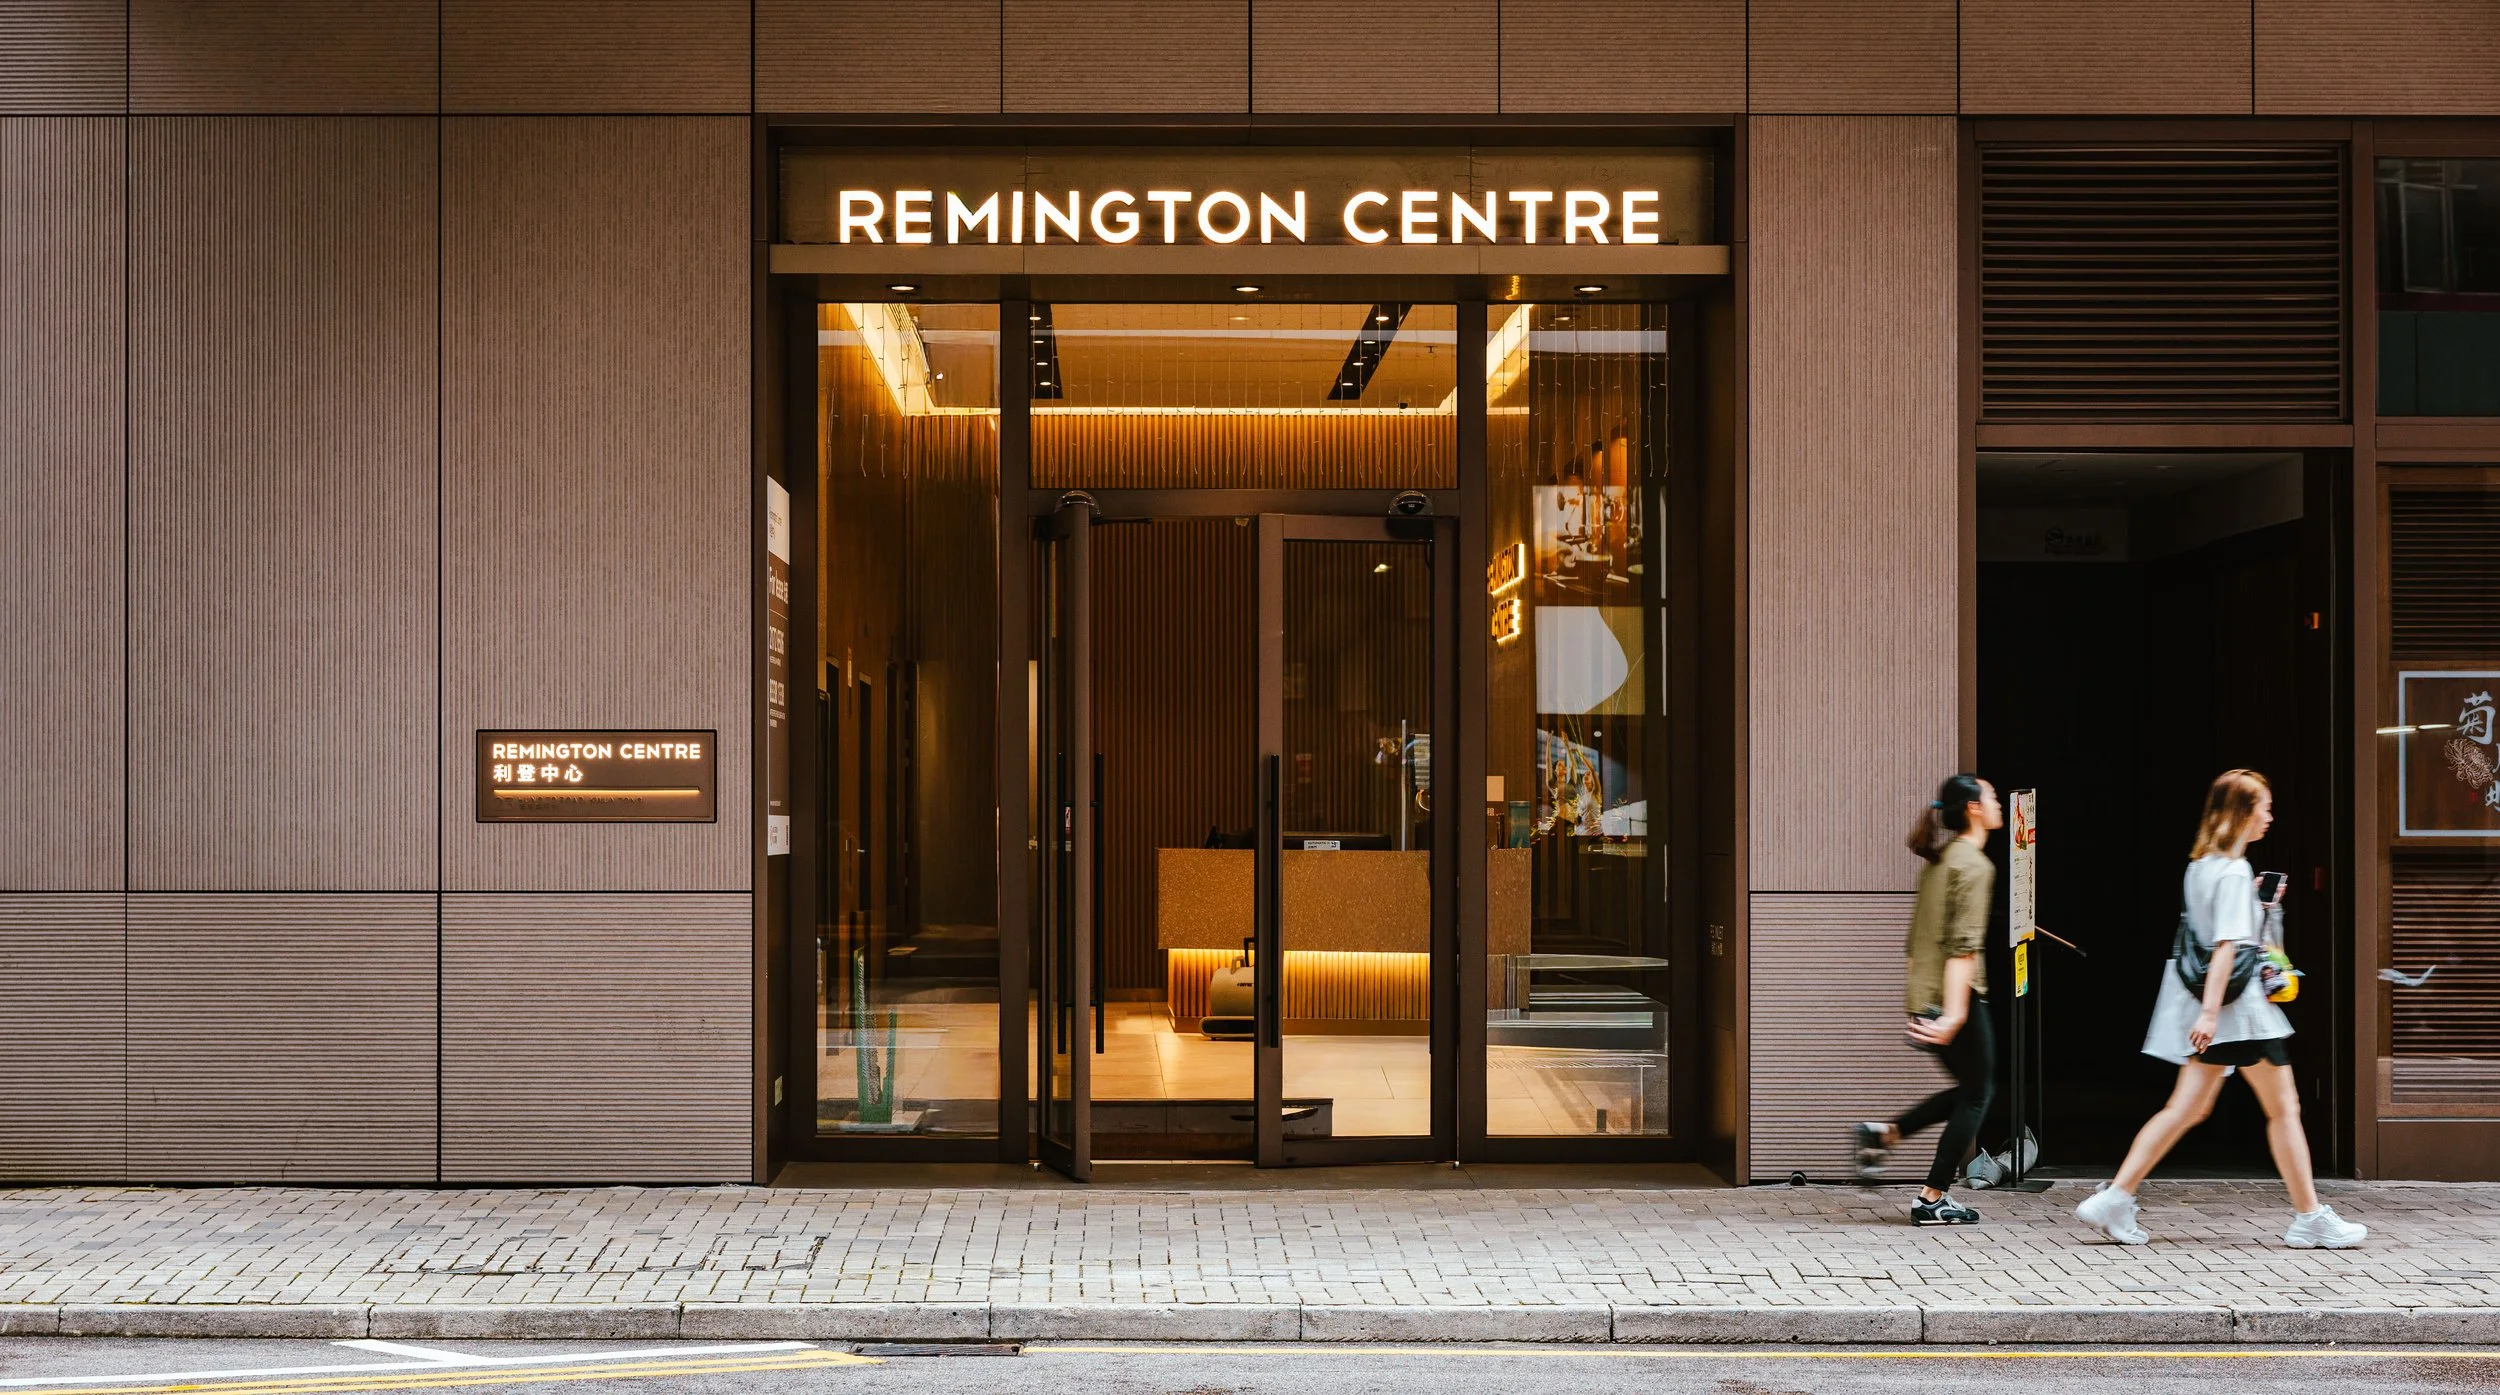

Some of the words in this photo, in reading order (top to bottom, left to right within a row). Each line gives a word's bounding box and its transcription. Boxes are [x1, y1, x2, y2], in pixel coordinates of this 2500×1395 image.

[839, 190, 1306, 244] REMINGTON
[1343, 190, 1660, 244] CENTRE
[492, 743, 612, 760] REMINGTON
[619, 743, 701, 760] CENTRE
[493, 763, 583, 782] 利登中心
